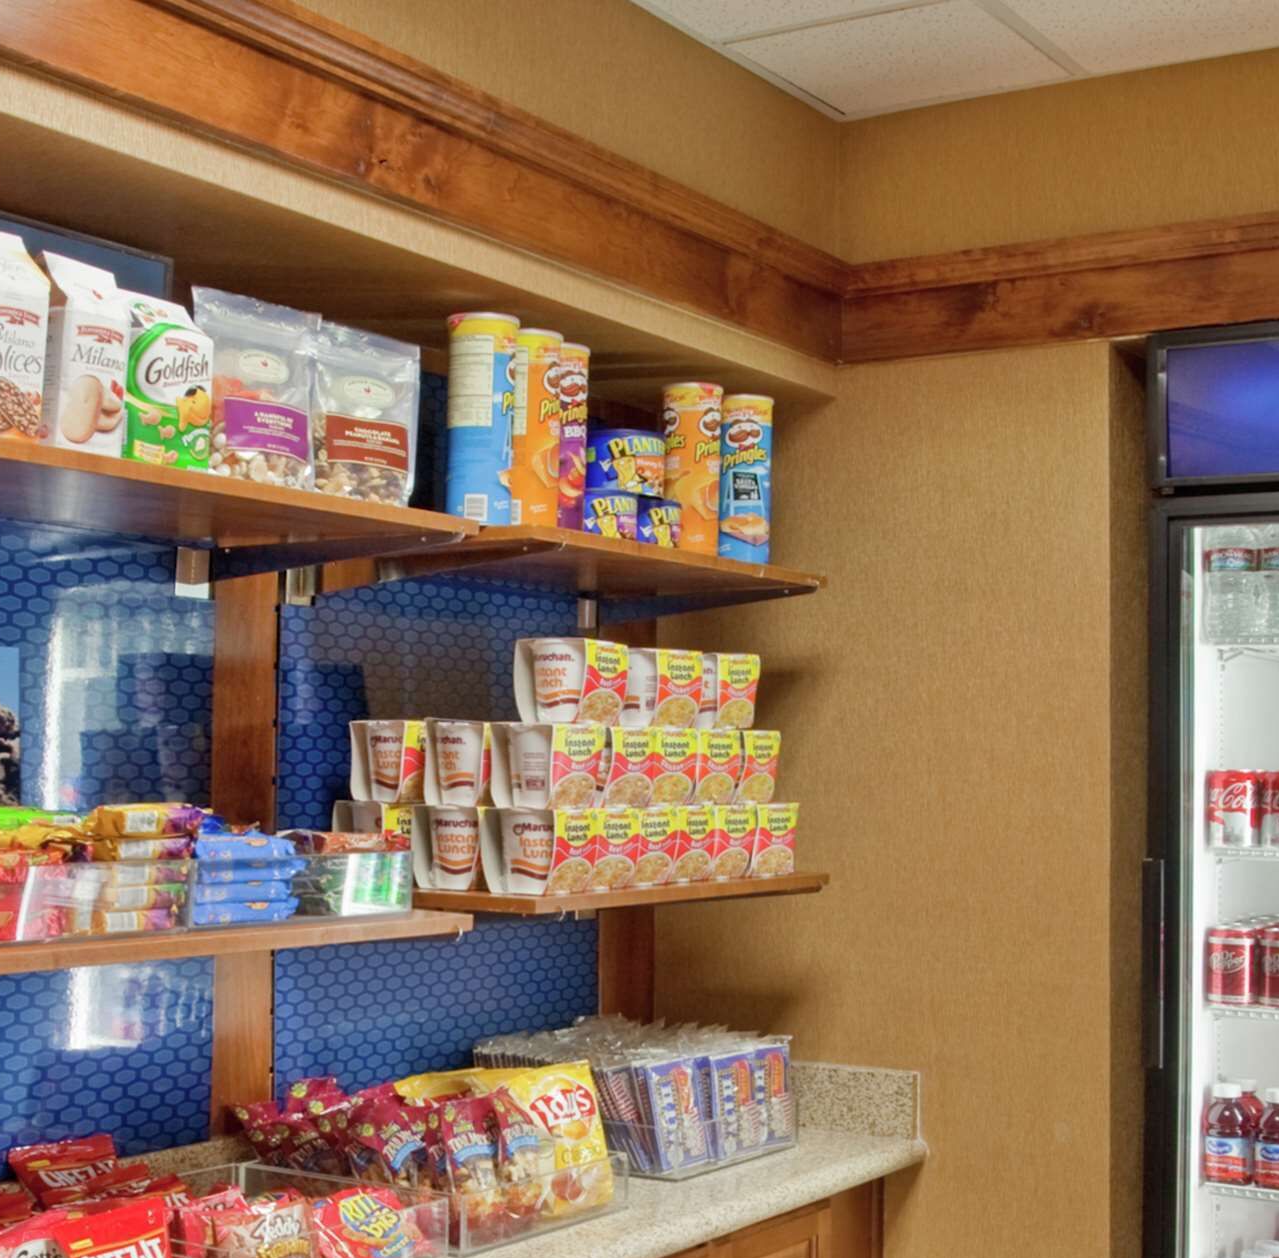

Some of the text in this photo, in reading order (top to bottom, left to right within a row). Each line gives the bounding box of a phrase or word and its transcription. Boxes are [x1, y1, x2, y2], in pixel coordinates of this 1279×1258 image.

[71, 342, 126, 372] Milano
[144, 354, 209, 386] Goldfish
[539, 399, 560, 422] Prin
[608, 435, 665, 458] PLANTE
[694, 438, 721, 463] Prin
[722, 446, 768, 471] Pringles
[592, 496, 638, 517] PLANT
[536, 1087, 593, 1127] Lay's
[340, 1192, 381, 1222] RITZ
[251, 1214, 301, 1247] Teddy
[359, 1207, 399, 1239] bits
